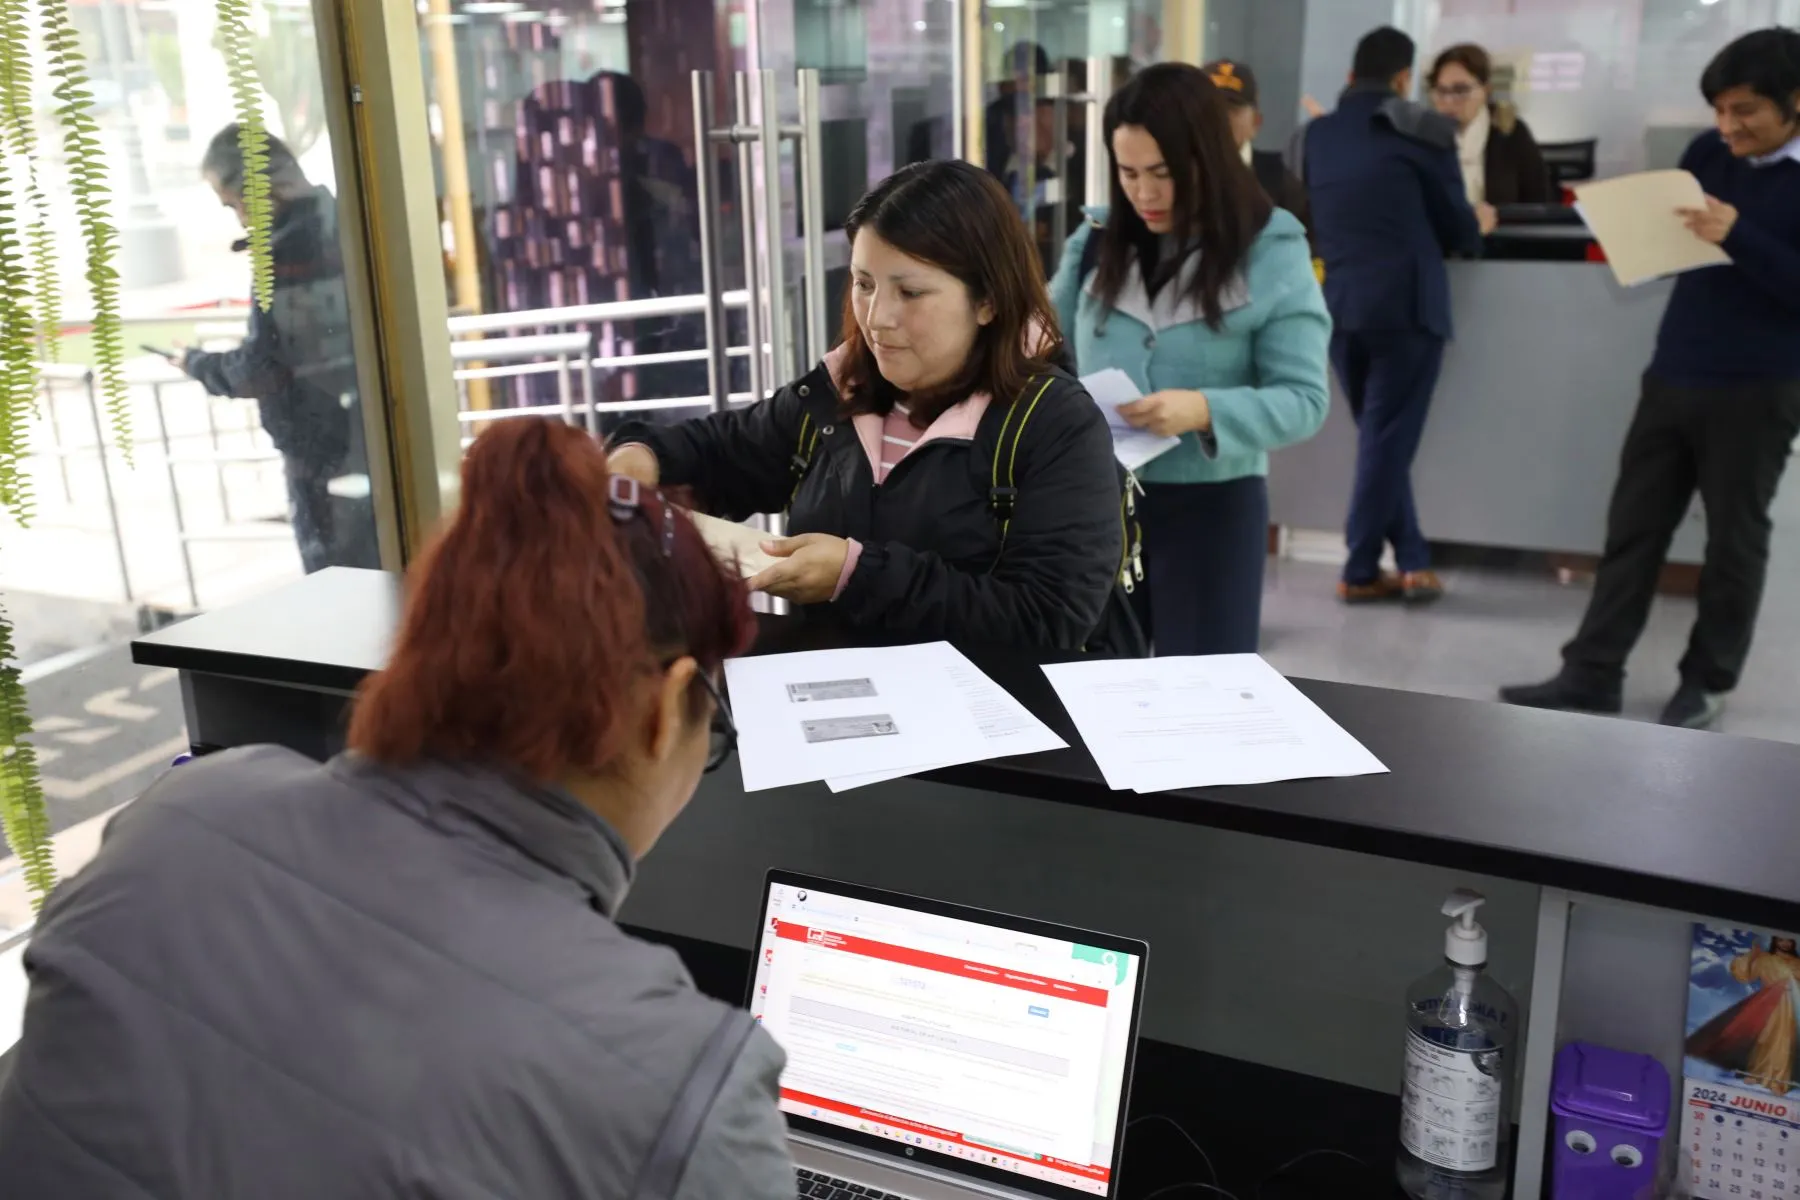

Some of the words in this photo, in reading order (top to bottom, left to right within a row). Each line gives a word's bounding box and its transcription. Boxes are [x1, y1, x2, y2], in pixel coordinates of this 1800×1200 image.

[1692, 1087, 1727, 1103] 2024
[1730, 1096, 1787, 1117] JUNIO
[1735, 1137, 1743, 1146] 4
[1710, 1163, 1722, 1172] 17
[1732, 1152, 1743, 1162] 11
[1753, 1157, 1766, 1167] 12
[1774, 1162, 1787, 1173] 13
[1708, 1178, 1720, 1189] 24
[1729, 1184, 1742, 1194] 25
